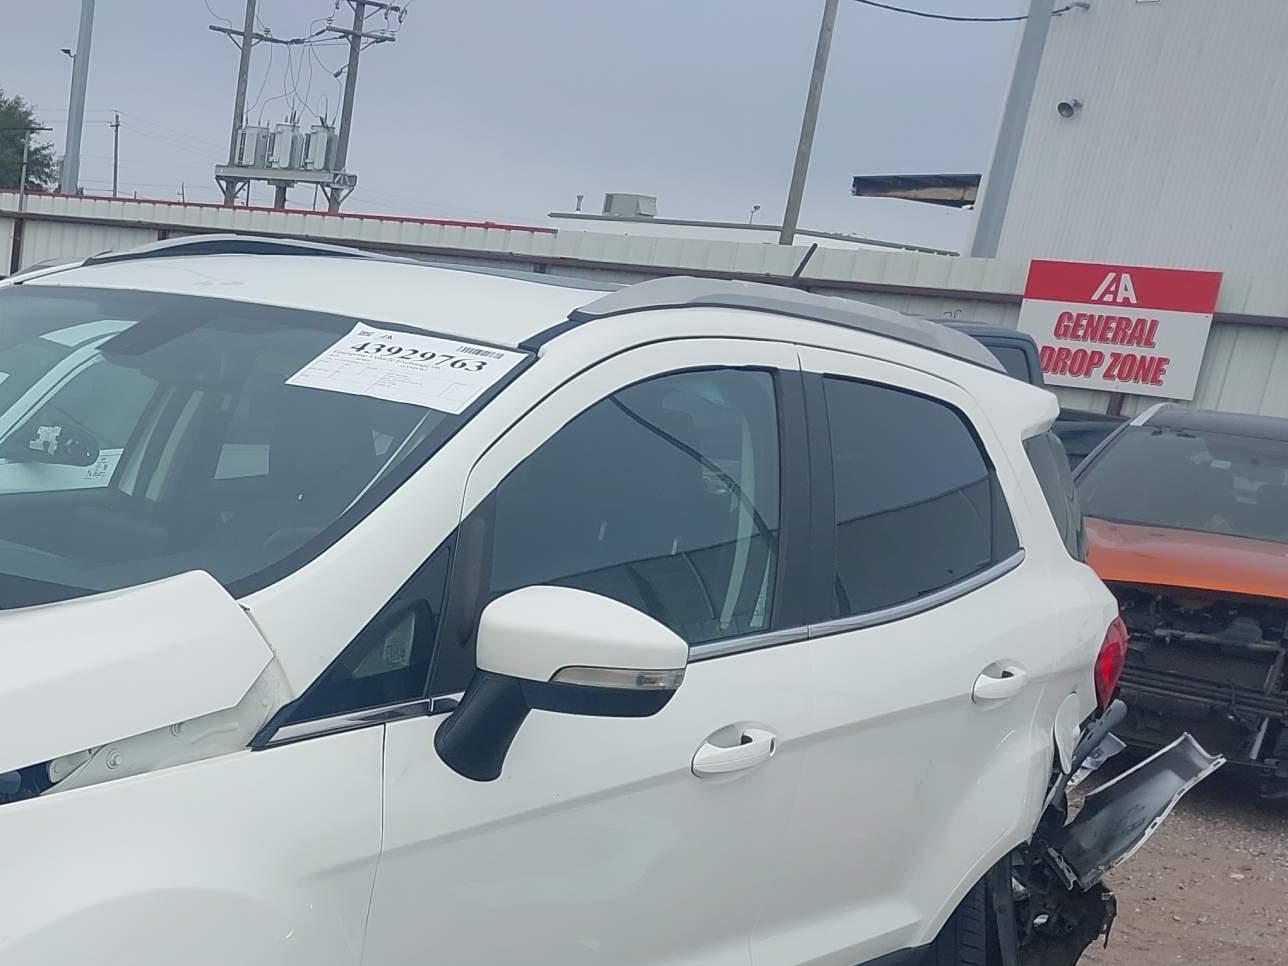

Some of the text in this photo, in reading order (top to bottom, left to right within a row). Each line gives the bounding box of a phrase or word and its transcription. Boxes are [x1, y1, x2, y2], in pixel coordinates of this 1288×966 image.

[1053, 311, 1159, 348] GENERAL
[351, 341, 488, 373] 43929763
[1040, 345, 1170, 386] DROP ZONE
